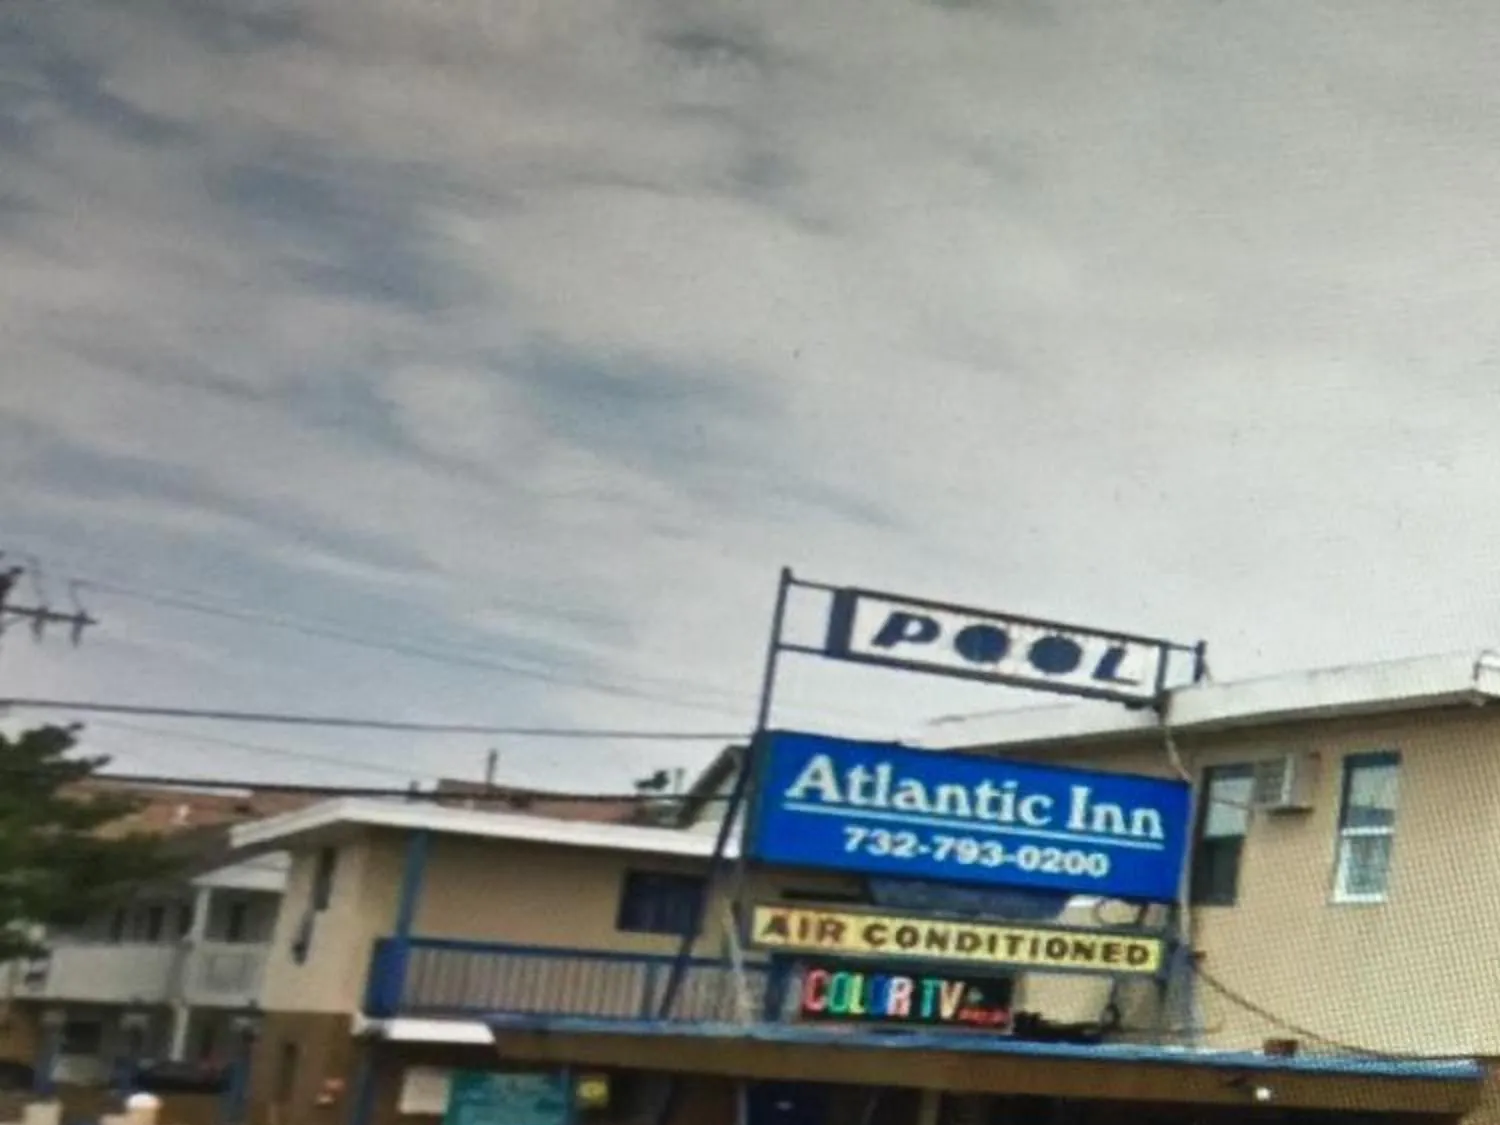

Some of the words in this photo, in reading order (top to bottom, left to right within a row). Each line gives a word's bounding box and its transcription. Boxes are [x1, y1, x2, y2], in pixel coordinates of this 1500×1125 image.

[871, 611, 1139, 686] POOL
[784, 753, 1054, 827] Atlantic
[1066, 784, 1165, 840] Inn
[843, 825, 1111, 878] 732-793-0200
[760, 914, 847, 948] AIR
[862, 923, 1151, 967] CONDITIONED
[804, 968, 914, 1019] COLOR
[920, 977, 965, 1020] TV
